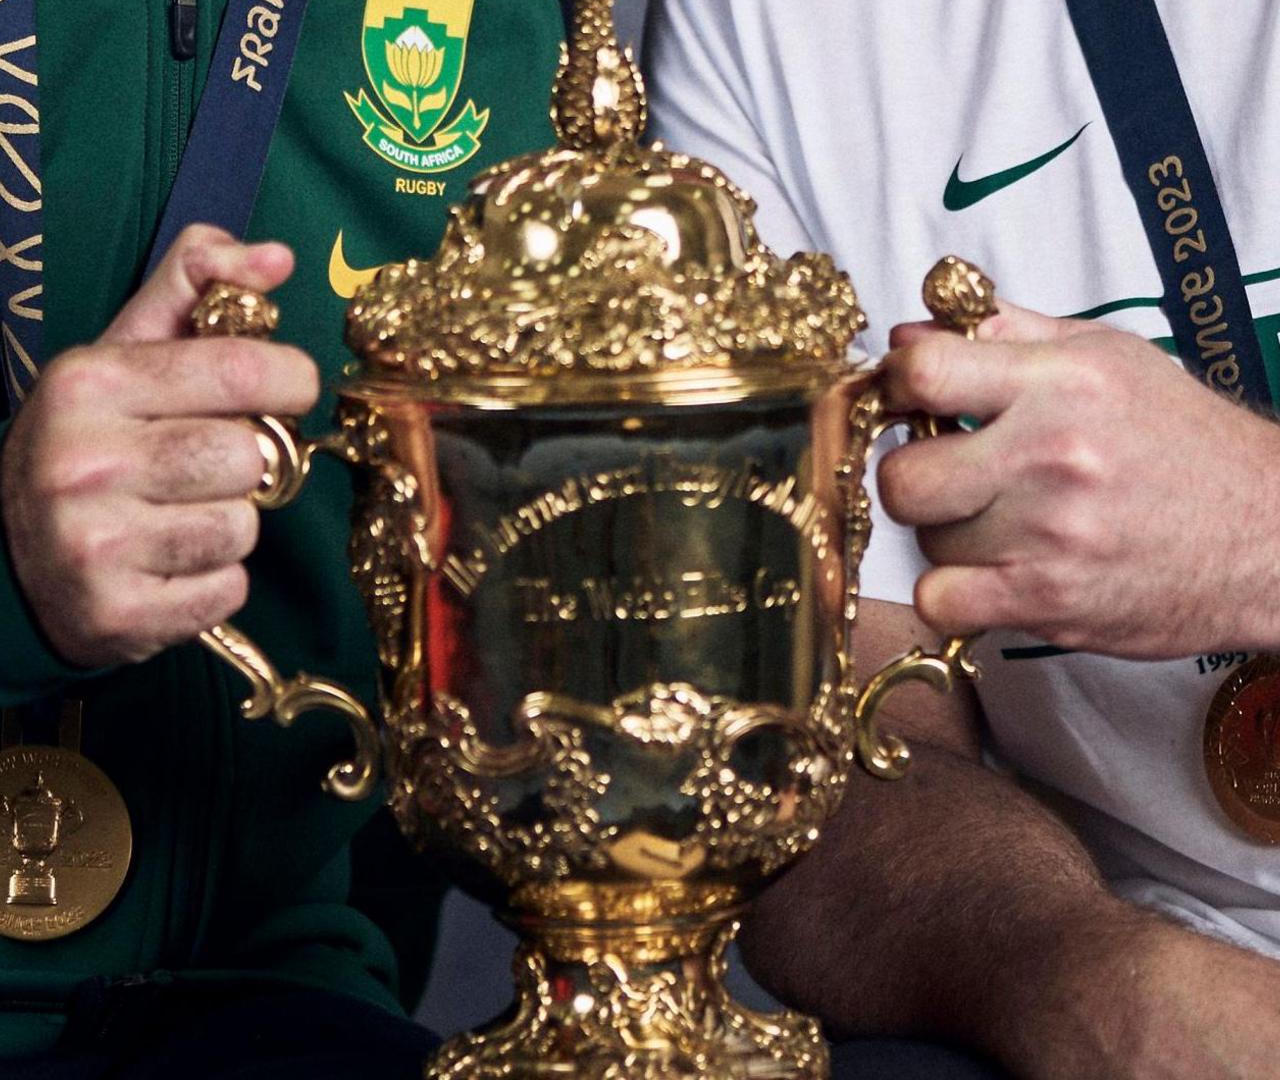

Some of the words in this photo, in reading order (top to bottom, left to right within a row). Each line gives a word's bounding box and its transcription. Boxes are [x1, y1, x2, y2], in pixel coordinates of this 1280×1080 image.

[379, 138, 419, 166] SOUTH
[421, 144, 464, 167] AFRICA
[394, 177, 446, 196] RUGBY
[1148, 154, 1208, 264] 2023
